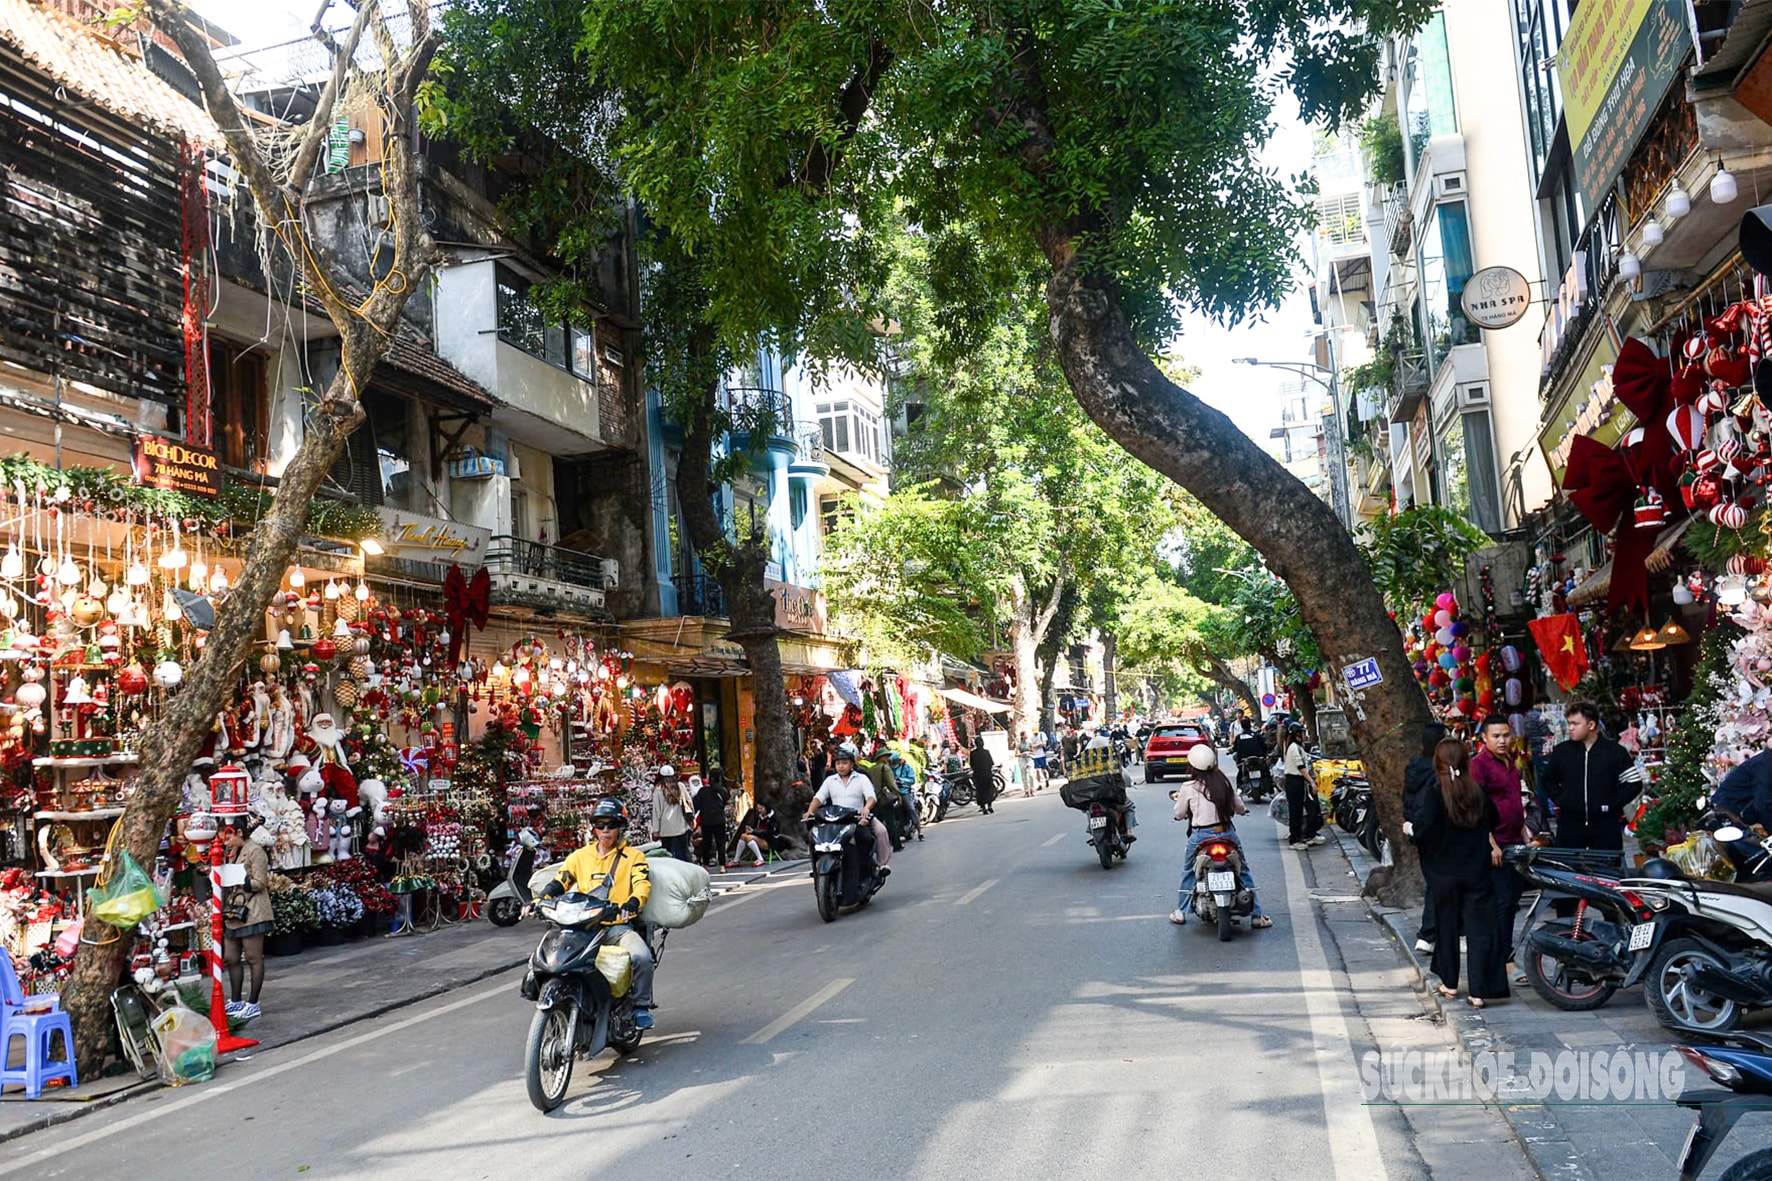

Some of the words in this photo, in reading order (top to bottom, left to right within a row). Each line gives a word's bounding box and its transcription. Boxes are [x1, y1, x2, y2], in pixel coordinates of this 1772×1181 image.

[1501, 295, 1525, 305] SPA
[1489, 312, 1506, 320] HÀNG
[166, 464, 194, 481] HÀNG
[1357, 662, 1370, 675] 77
